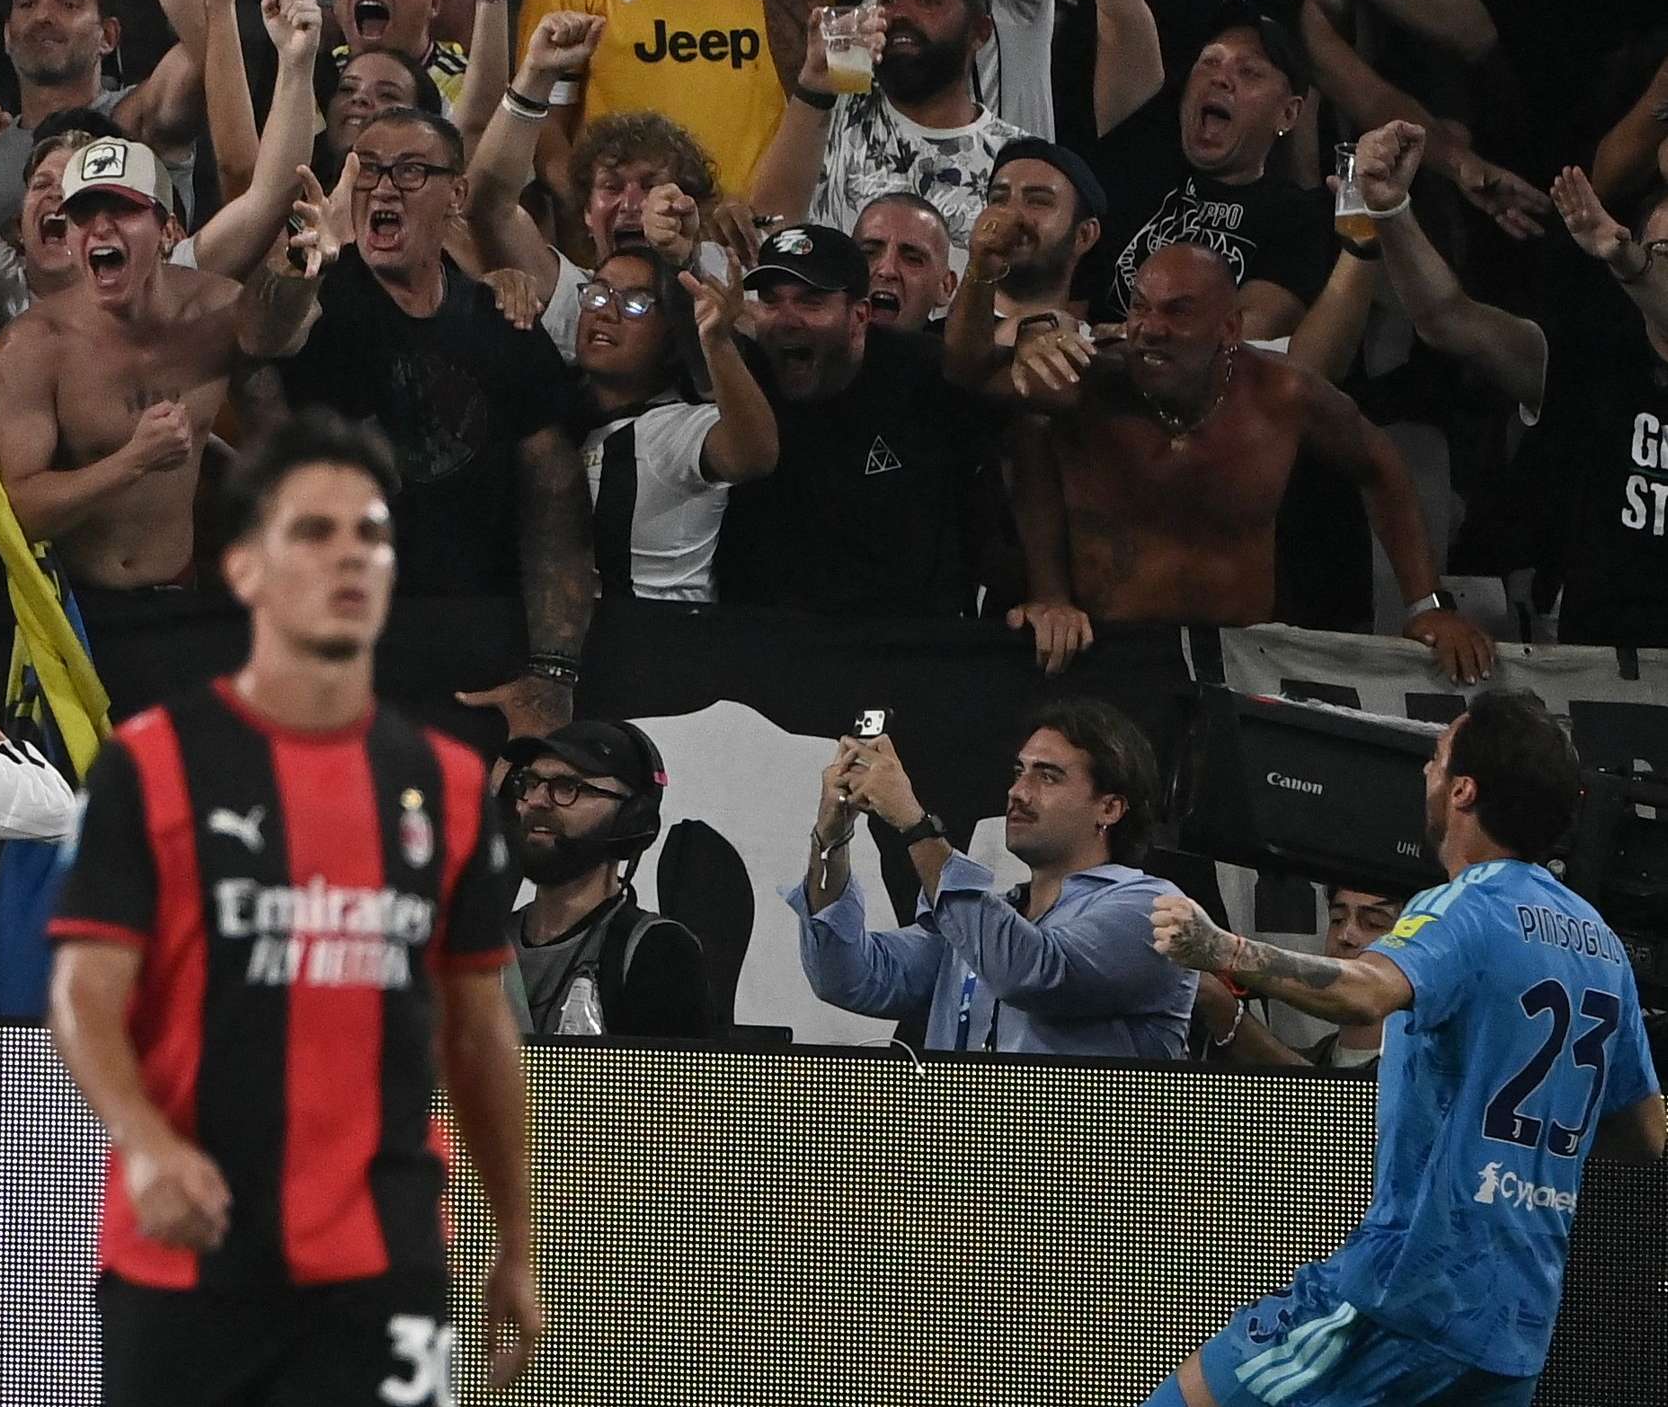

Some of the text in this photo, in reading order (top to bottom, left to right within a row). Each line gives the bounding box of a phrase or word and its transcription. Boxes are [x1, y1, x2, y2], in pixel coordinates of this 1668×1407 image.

[633, 19, 761, 70] Jeep
[1266, 771, 1324, 796] Canon
[1481, 978, 1620, 1159] 23
